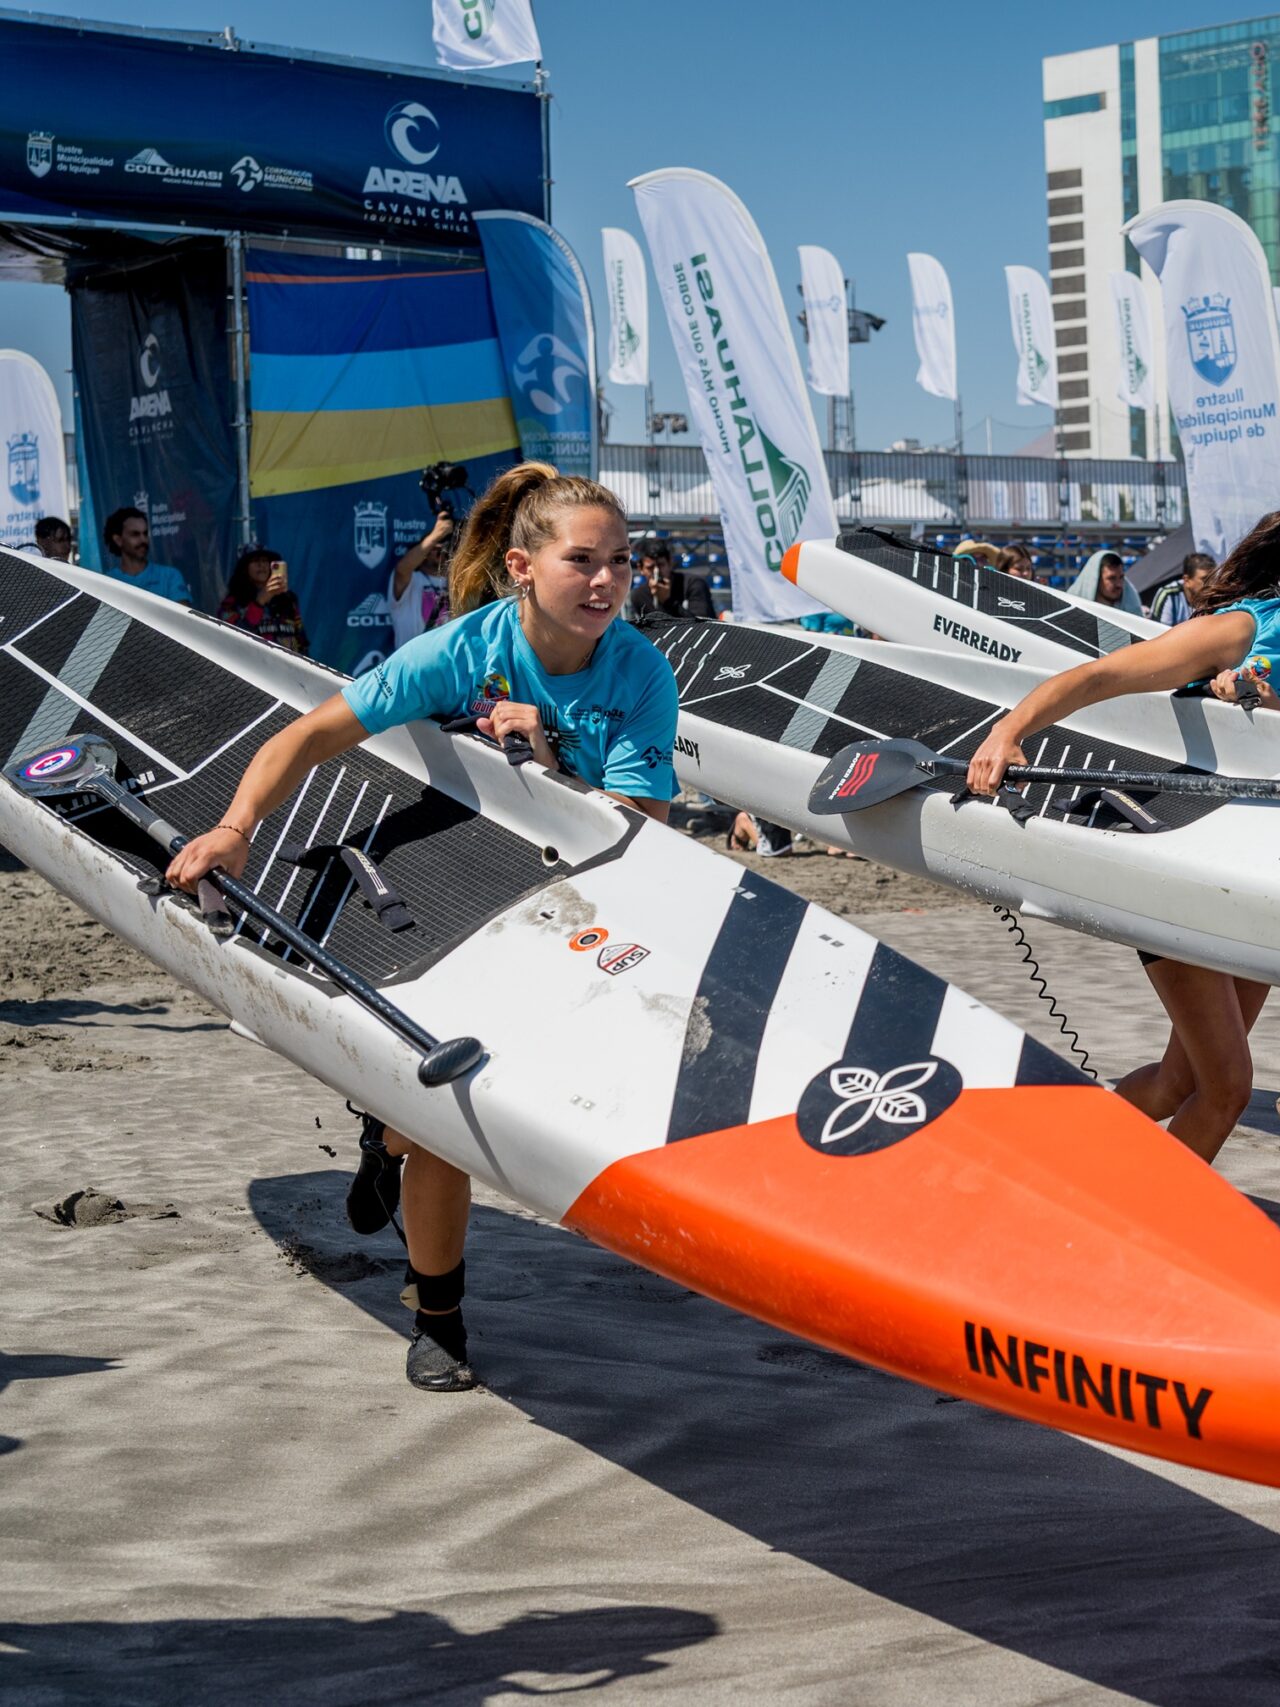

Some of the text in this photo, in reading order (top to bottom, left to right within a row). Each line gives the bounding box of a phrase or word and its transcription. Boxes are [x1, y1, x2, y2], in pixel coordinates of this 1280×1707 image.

[124, 163, 223, 180] COLLAHUASI
[264, 174, 313, 187] MUNICIPAL
[362, 165, 468, 204] ARENA
[364, 200, 469, 222] CAVANCHA
[434, 222, 470, 233] CHILE
[393, 519, 427, 531] Ilustre
[933, 613, 1022, 663] EVERREADY
[612, 950, 644, 972] SUP
[964, 1320, 1213, 1440] INFINITY
